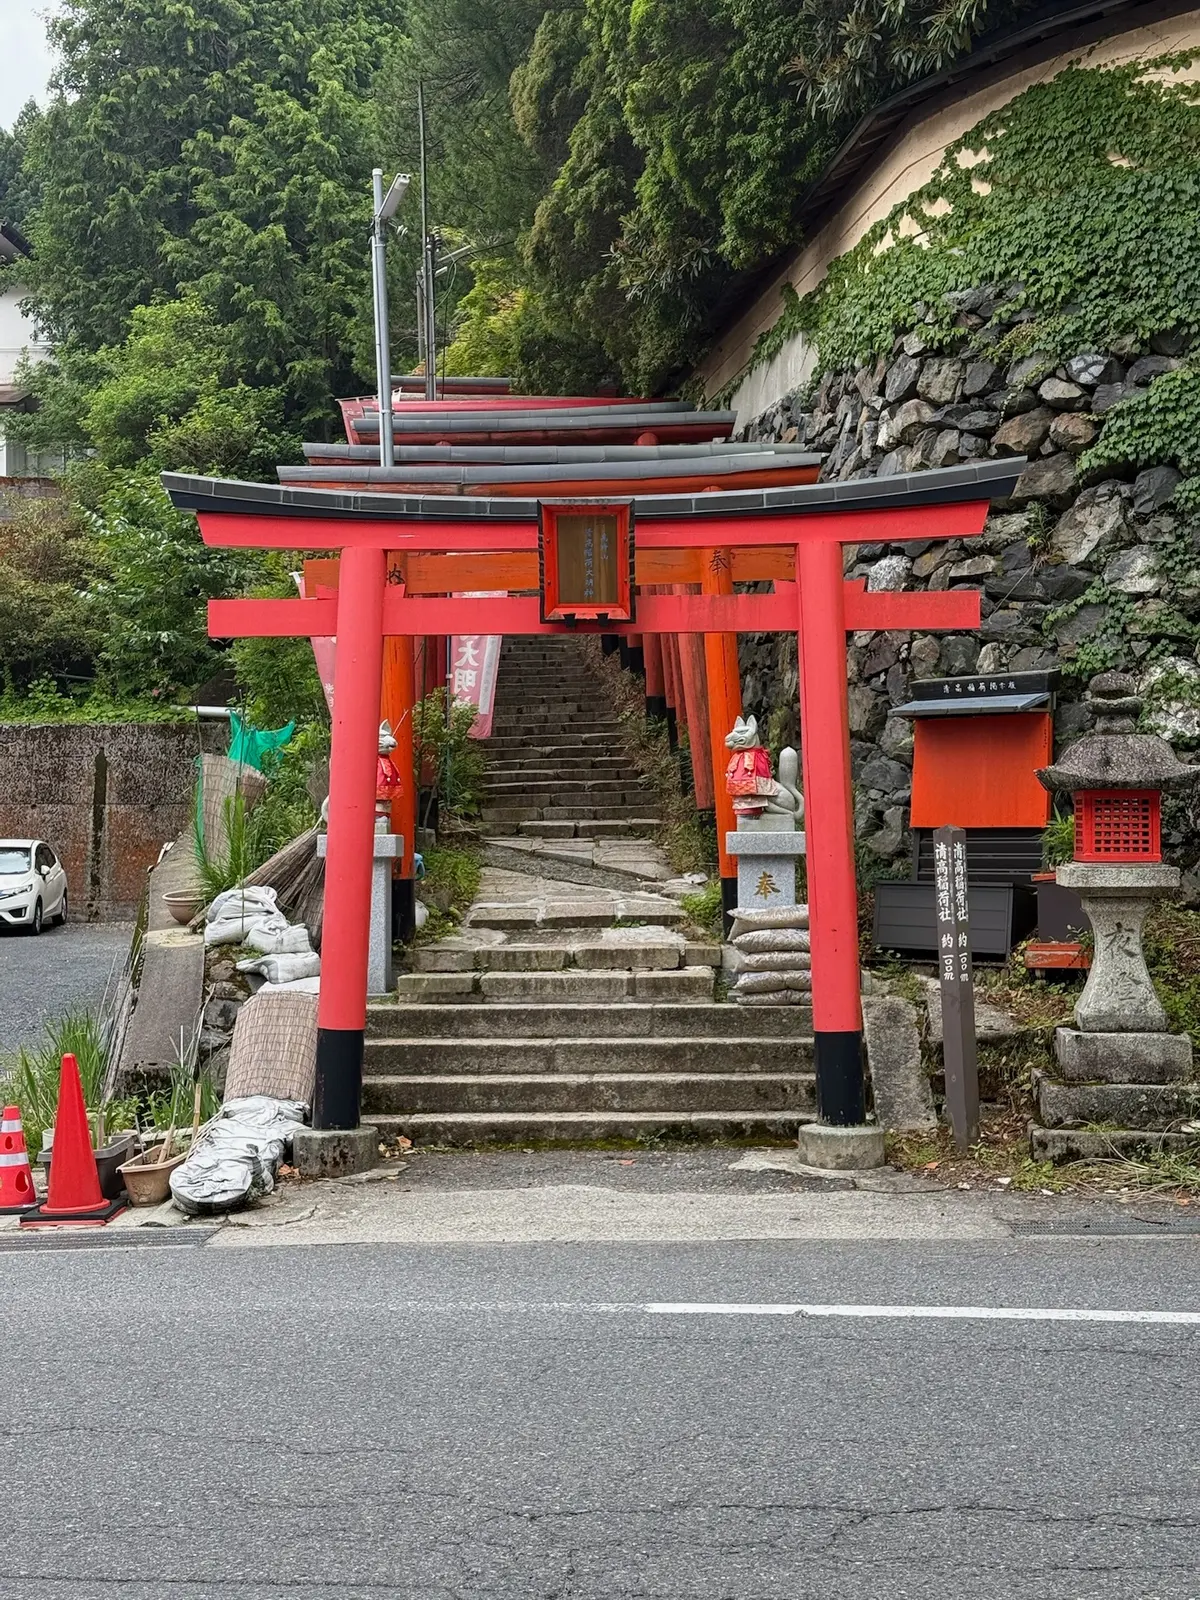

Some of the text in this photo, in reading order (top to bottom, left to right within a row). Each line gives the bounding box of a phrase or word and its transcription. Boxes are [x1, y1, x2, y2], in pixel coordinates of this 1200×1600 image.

[709, 549, 728, 575] 奉
[453, 636, 479, 707] 大明
[753, 871, 781, 900] 奉
[935, 841, 951, 922] 清高稲荷社
[953, 841, 967, 922] 清高稲荷社
